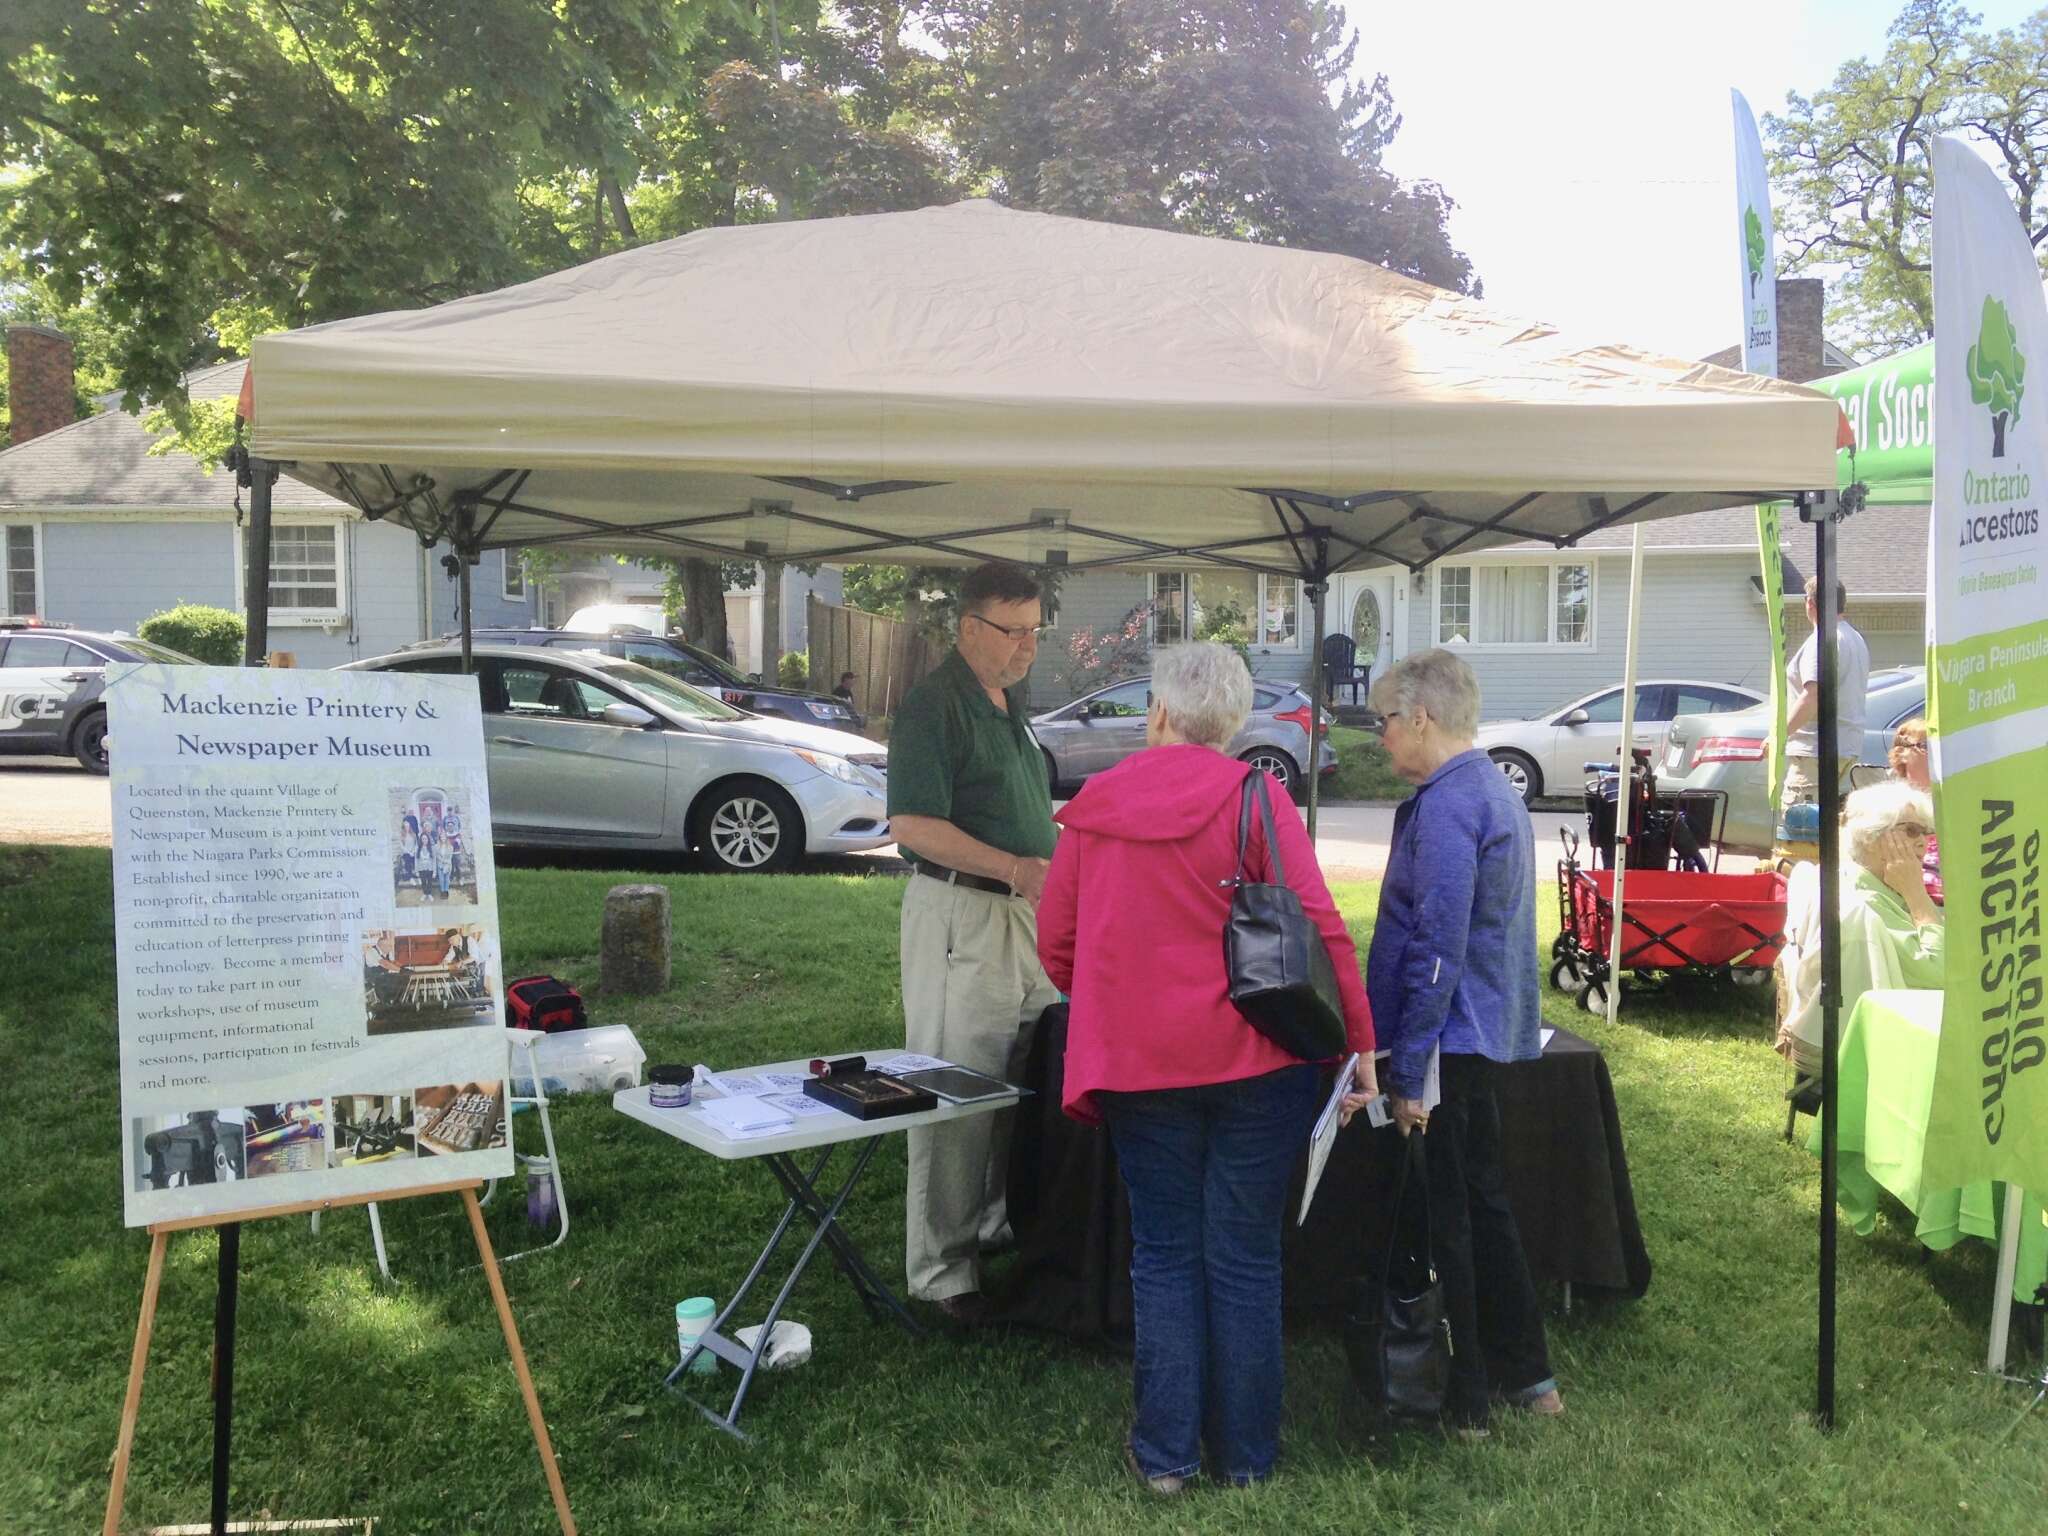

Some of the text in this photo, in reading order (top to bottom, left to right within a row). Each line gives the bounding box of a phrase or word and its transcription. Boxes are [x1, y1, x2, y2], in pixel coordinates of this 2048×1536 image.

[1964, 463, 2030, 504] Ontario
[1967, 678, 2016, 712] Branch
[161, 693, 439, 722] Mackenzie Printery &
[176, 734, 431, 760] Newspaper Museum
[130, 784, 338, 800] Located in the quaint Village of
[214, 805, 282, 817] Mackenzie
[287, 805, 337, 818] Printery
[341, 805, 354, 816] &
[131, 827, 377, 842] Newspaper Museum is a joint venture
[131, 849, 161, 862] with
[167, 850, 188, 861] the
[192, 849, 244, 862] Niagara
[249, 848, 283, 860] Parks
[133, 870, 210, 884] Established
[214, 871, 249, 883] since
[291, 871, 311, 880] we
[313, 871, 333, 880] are
[336, 870, 344, 879] a
[212, 889, 277, 904] charitable
[281, 889, 359, 903] organization
[134, 907, 364, 929] committed to the preservation and
[135, 931, 349, 951] education of letterpress printing
[224, 957, 275, 969] Become
[279, 958, 287, 966] a
[292, 952, 344, 965] member
[137, 978, 302, 997] today to take part in our
[219, 1004, 242, 1015] use
[245, 1000, 260, 1012] of
[263, 999, 319, 1011] museum
[224, 1017, 314, 1036] informational
[203, 1046, 288, 1064] participation
[294, 1042, 307, 1054] in
[311, 1036, 360, 1052] festivals
[140, 1074, 165, 1089] and
